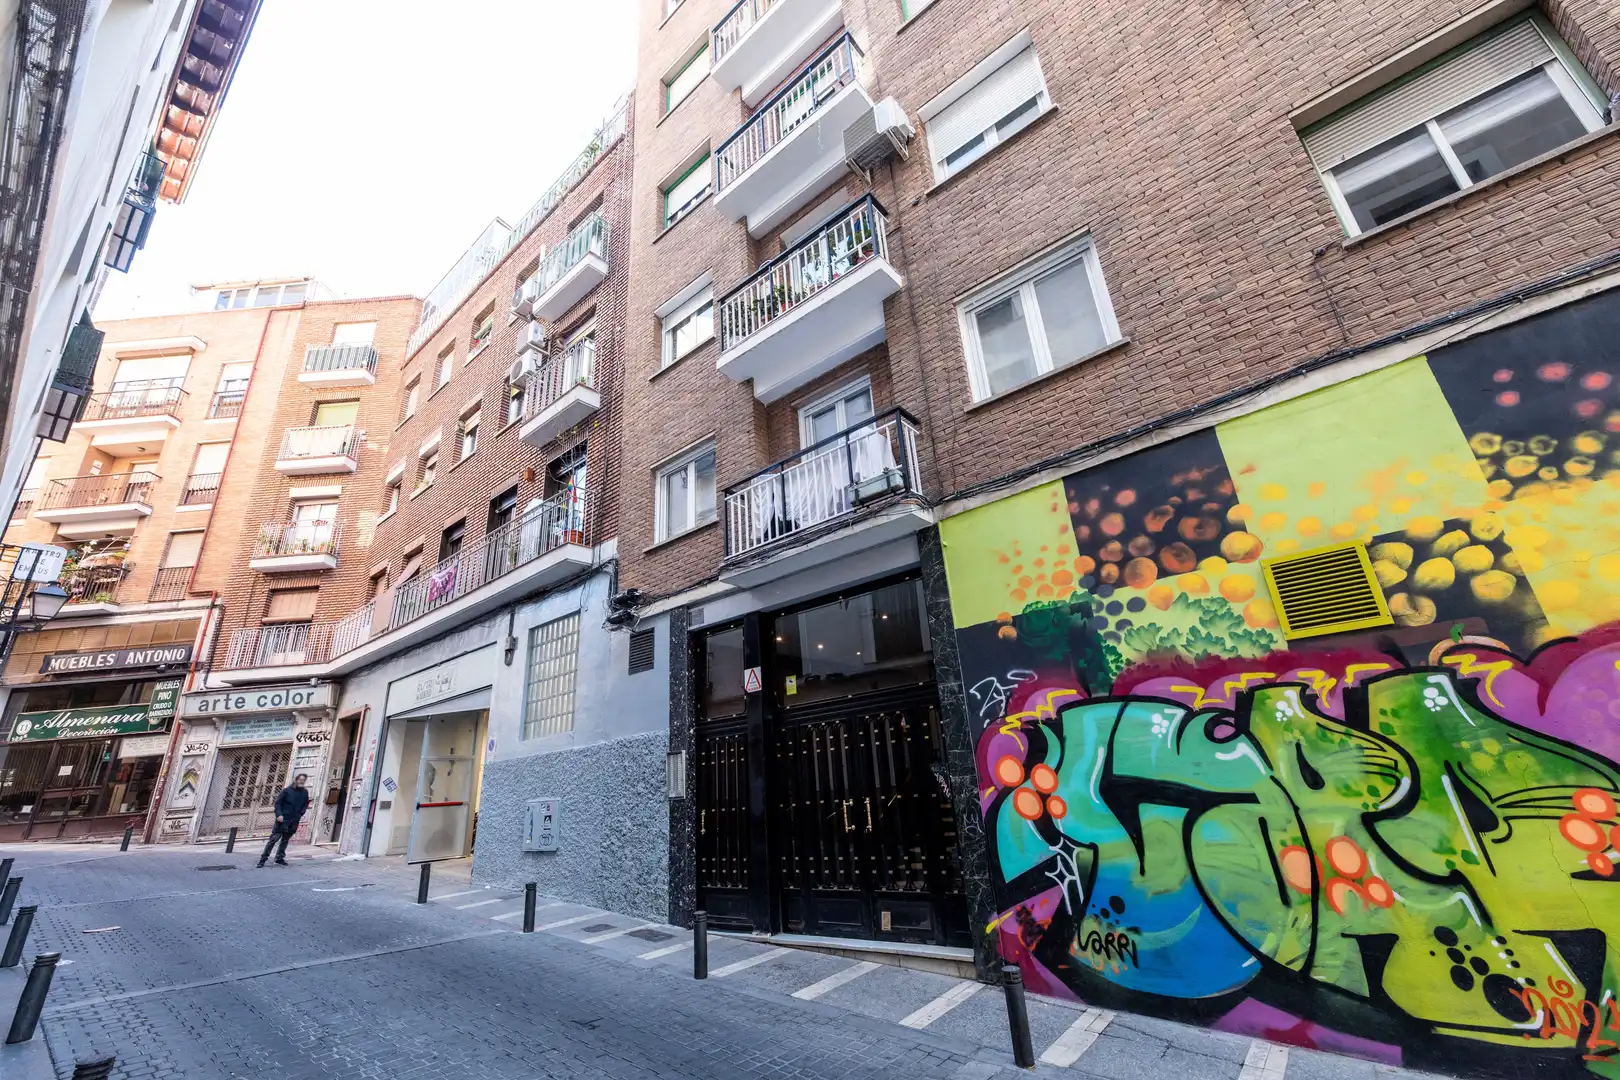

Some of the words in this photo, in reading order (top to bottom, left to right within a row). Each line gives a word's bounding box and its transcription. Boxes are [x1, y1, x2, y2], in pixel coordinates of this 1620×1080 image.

[25, 549, 61, 558] RATRO
[18, 565, 49, 575] EMUS
[48, 653, 116, 671] MUEBLES
[125, 648, 186, 665] ANTONIO
[155, 680, 180, 690] MUEBLES
[157, 691, 172, 701] PINO
[198, 693, 246, 712] arte
[256, 689, 315, 708] color
[34, 711, 148, 730] Almenara
[57, 726, 119, 738] Decoración
